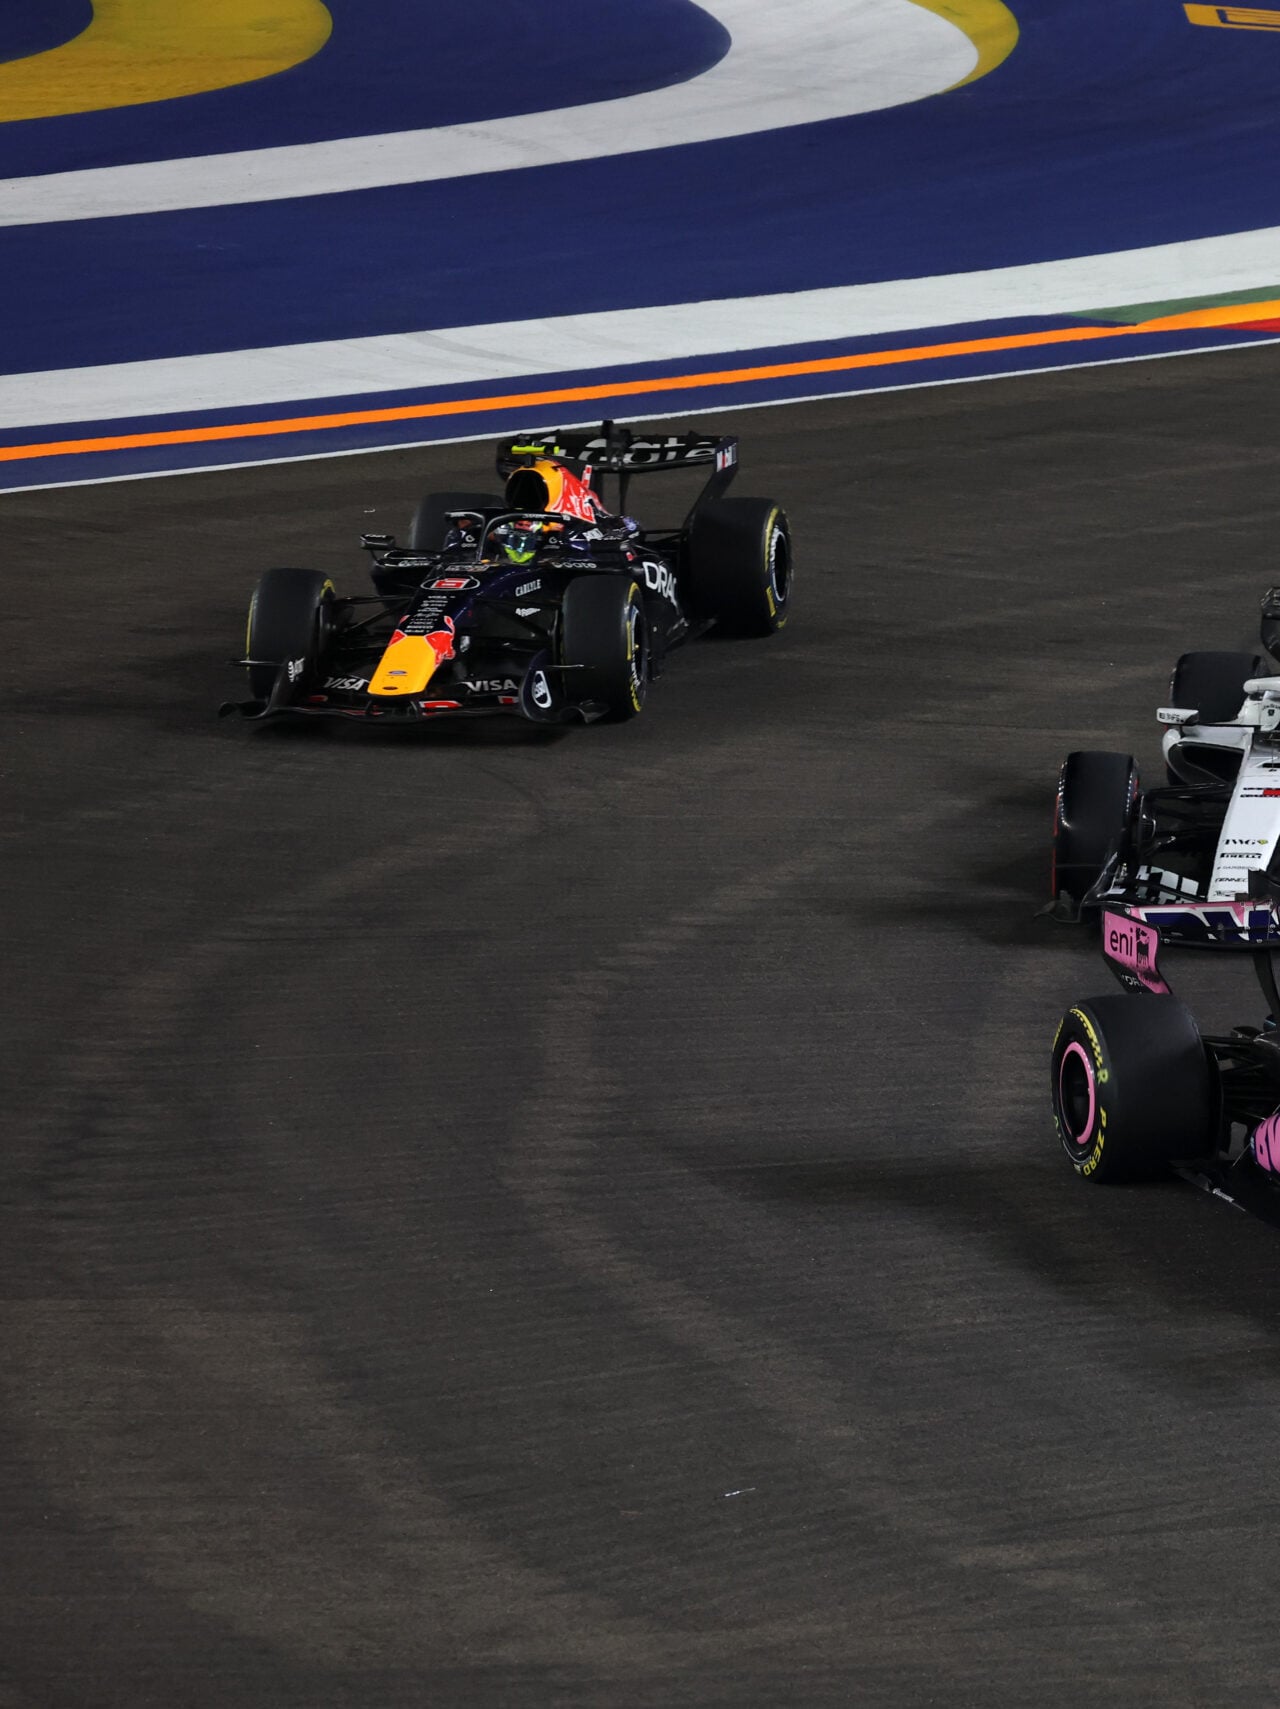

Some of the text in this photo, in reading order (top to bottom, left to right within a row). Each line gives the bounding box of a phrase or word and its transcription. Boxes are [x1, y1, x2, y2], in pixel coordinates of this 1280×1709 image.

[430, 577, 470, 589] 6
[323, 676, 368, 690] VISA
[458, 679, 518, 692] VISA
[1110, 927, 1133, 957] eni
